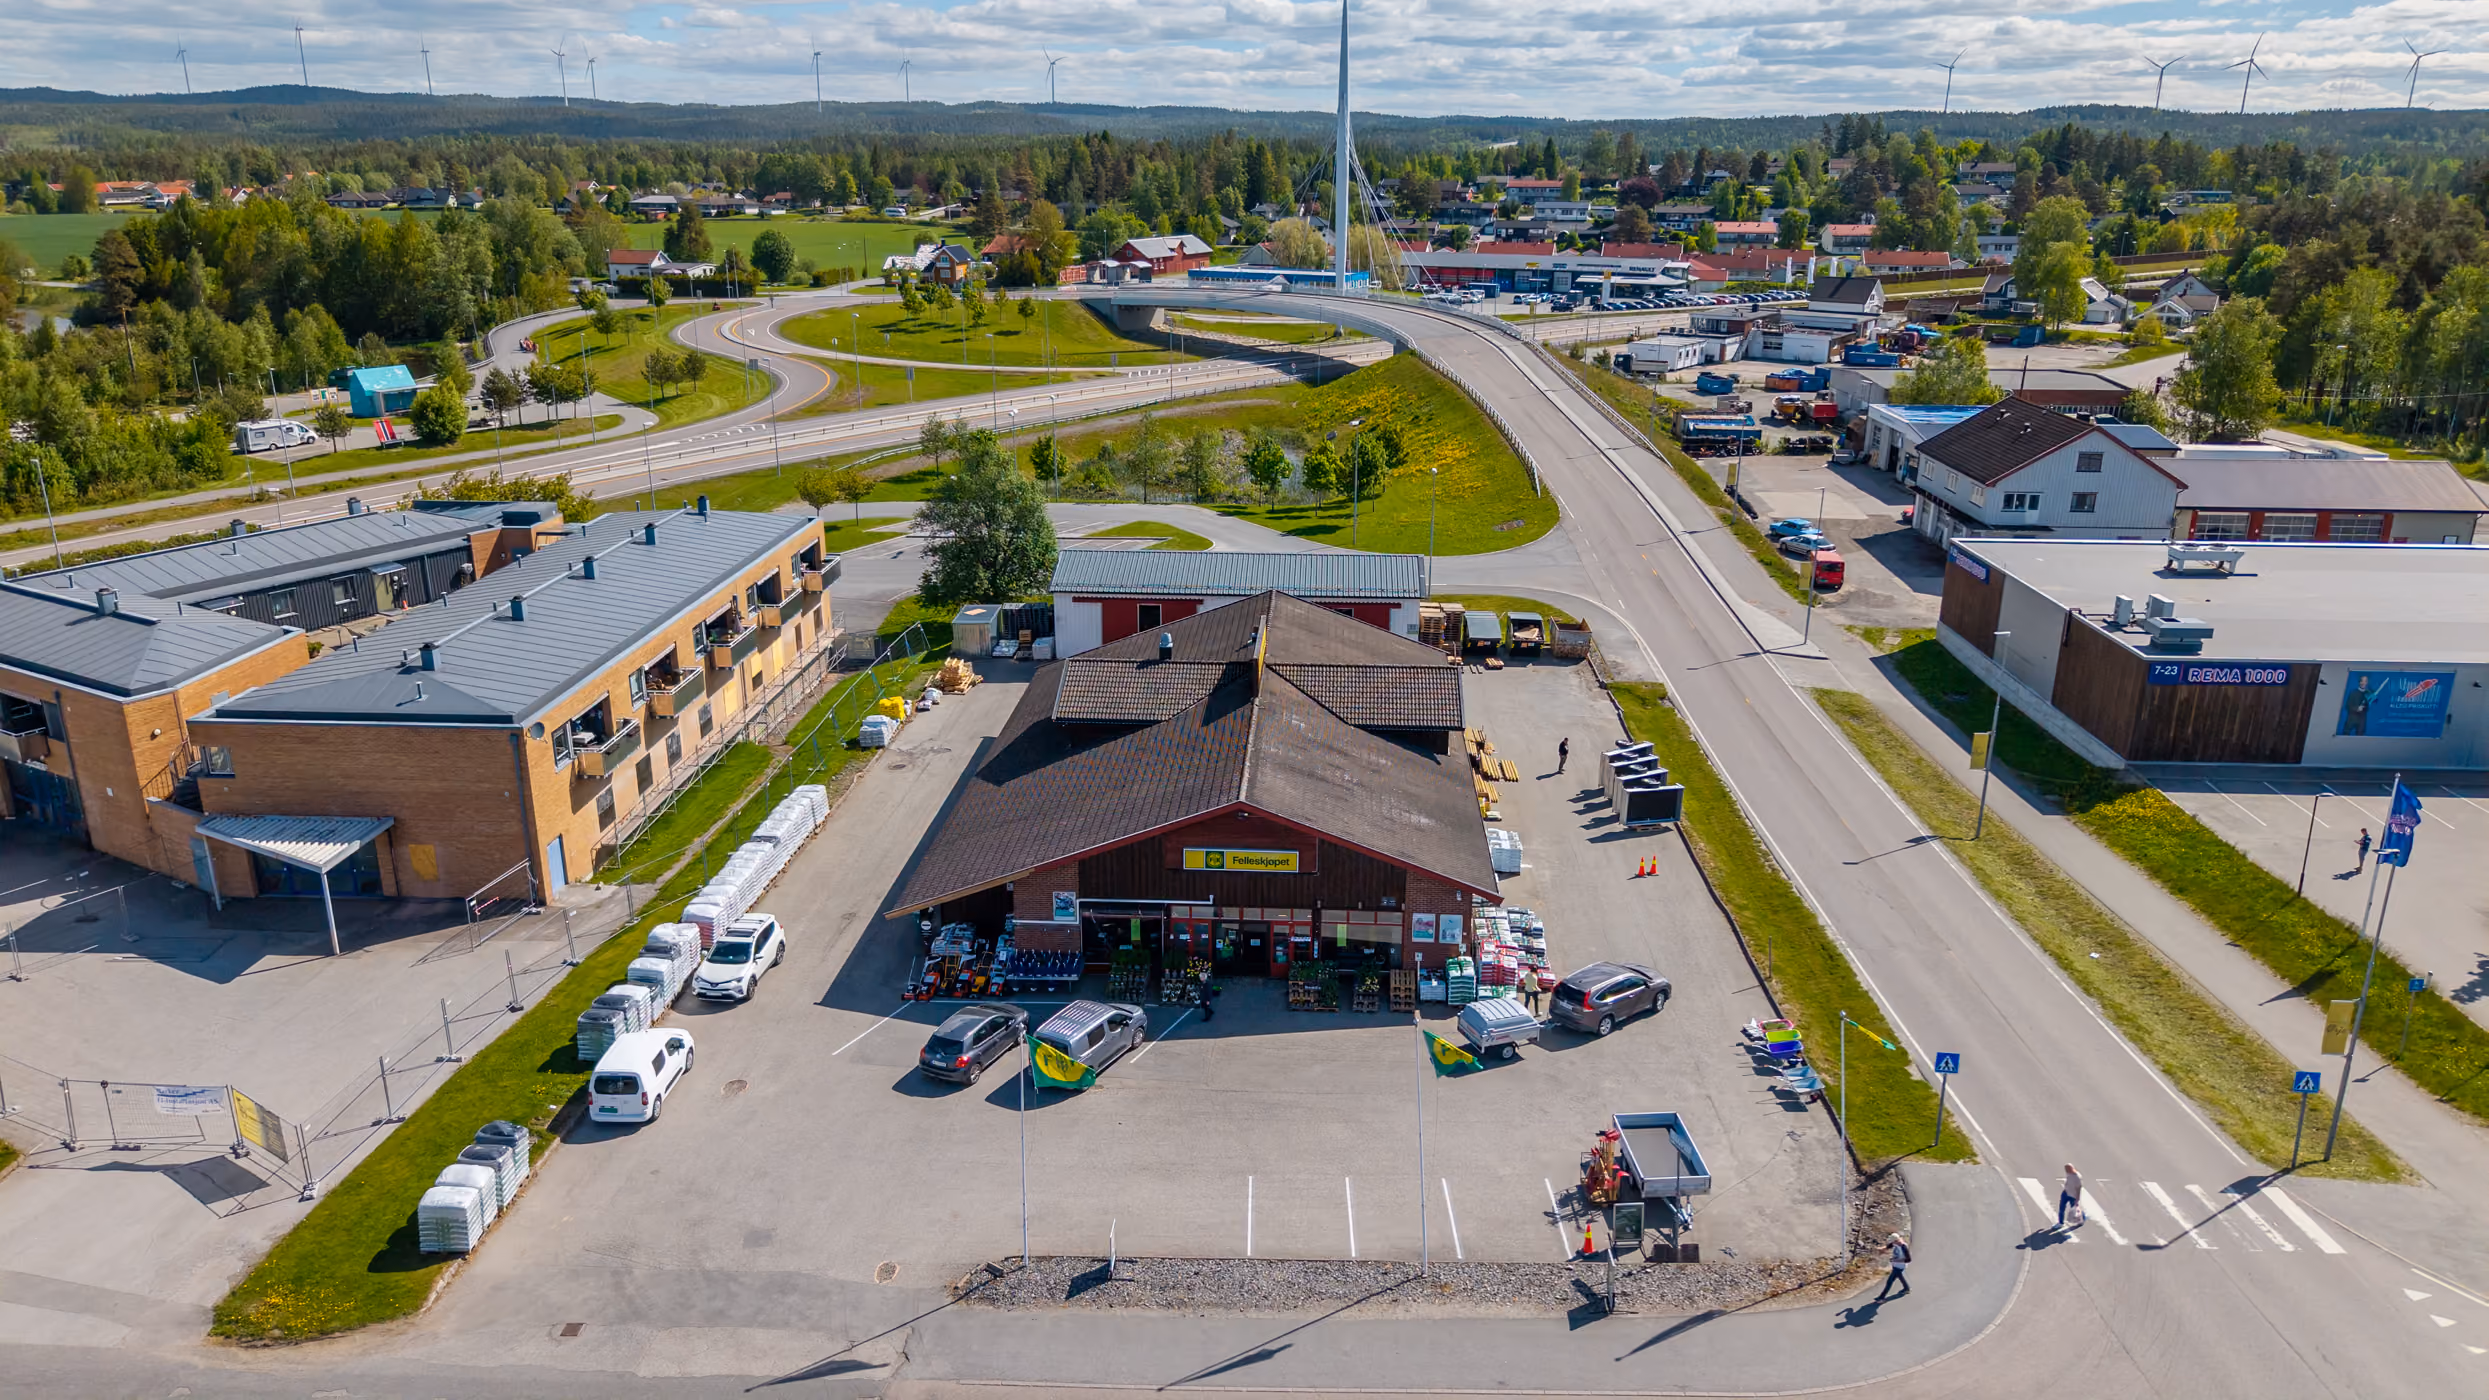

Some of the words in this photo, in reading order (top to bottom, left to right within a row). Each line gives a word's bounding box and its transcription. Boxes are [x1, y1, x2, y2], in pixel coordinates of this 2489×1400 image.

[2154, 665, 2178, 675] 7-23
[2188, 668, 2241, 682] REMA
[2245, 669, 2286, 683] 1000
[1232, 856, 1290, 867] Felleskjøpet
